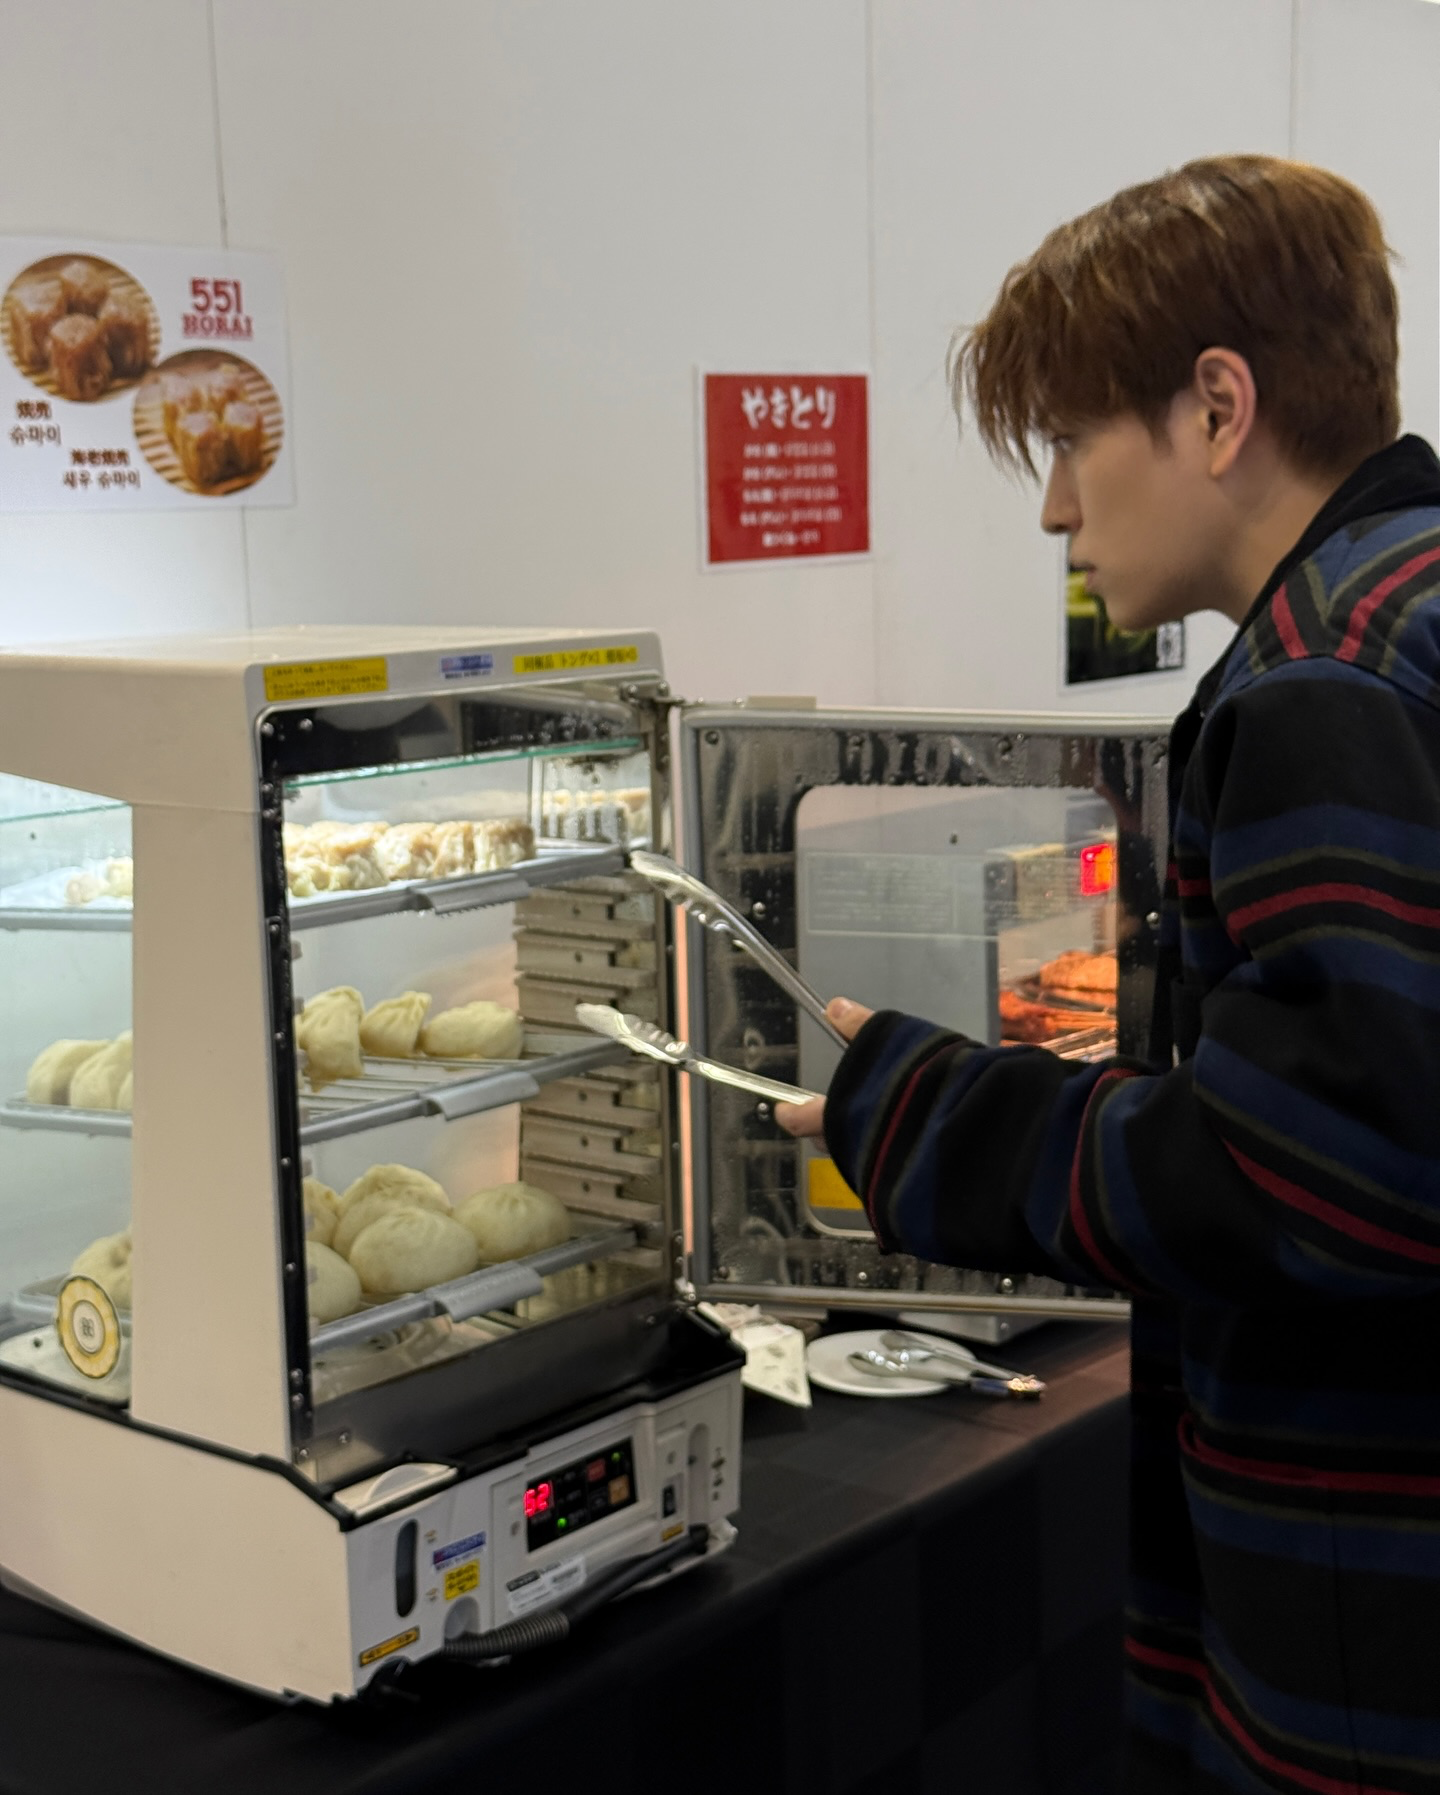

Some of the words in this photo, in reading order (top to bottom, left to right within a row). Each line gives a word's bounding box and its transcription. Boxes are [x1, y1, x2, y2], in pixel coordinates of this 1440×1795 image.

[190, 277, 242, 313] 551
[183, 313, 252, 337] HORAI
[741, 385, 836, 429] やきとり
[10, 424, 61, 446] 슈마이
[98, 469, 141, 489] 슈마이
